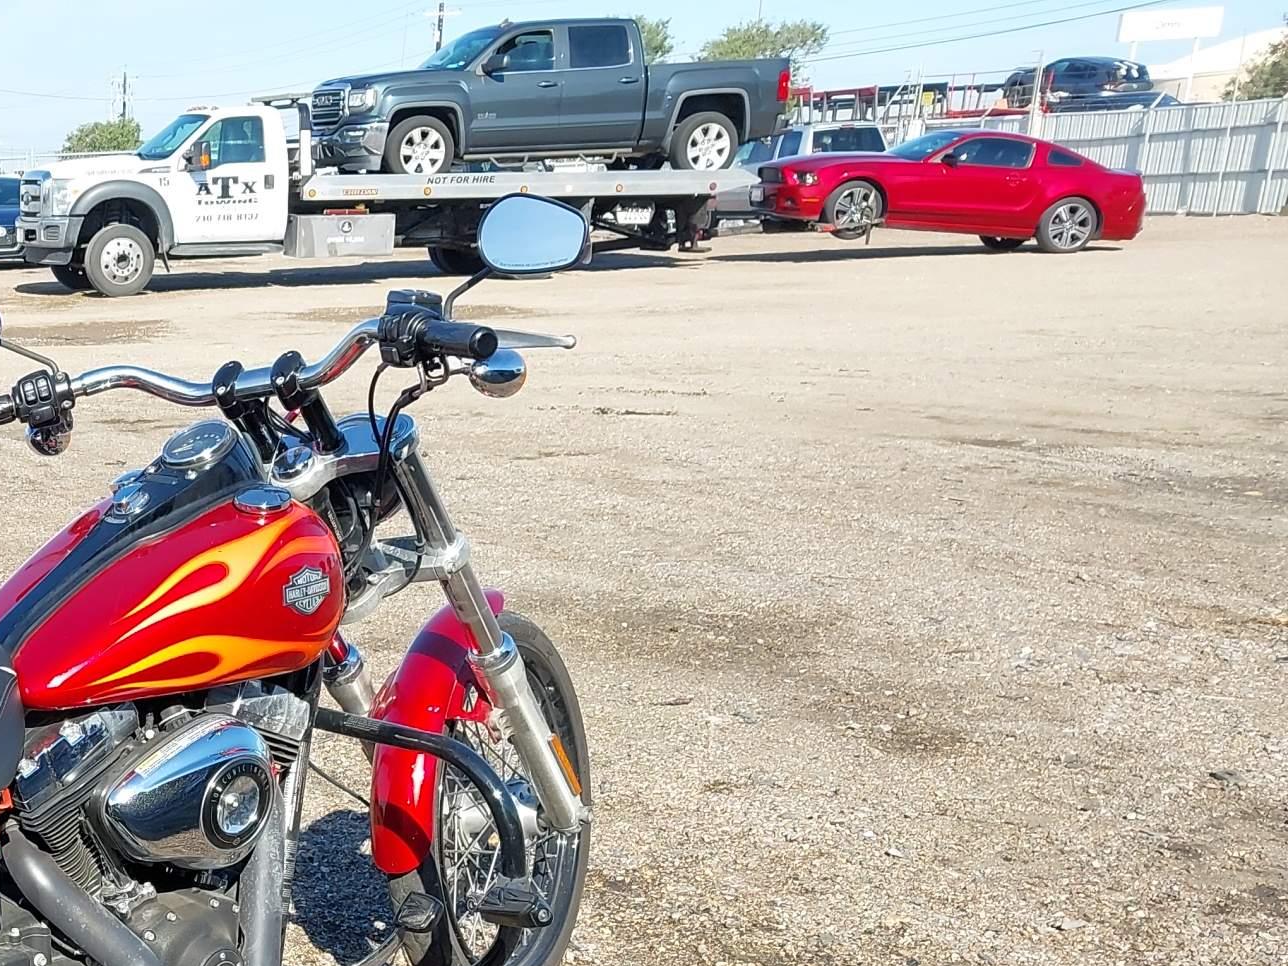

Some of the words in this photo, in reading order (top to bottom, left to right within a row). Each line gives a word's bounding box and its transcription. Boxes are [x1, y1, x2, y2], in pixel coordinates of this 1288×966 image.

[196, 176, 257, 199] ATX
[427, 177, 447, 185] NOT
[450, 176, 469, 184] FOR
[472, 175, 496, 184] HIRE
